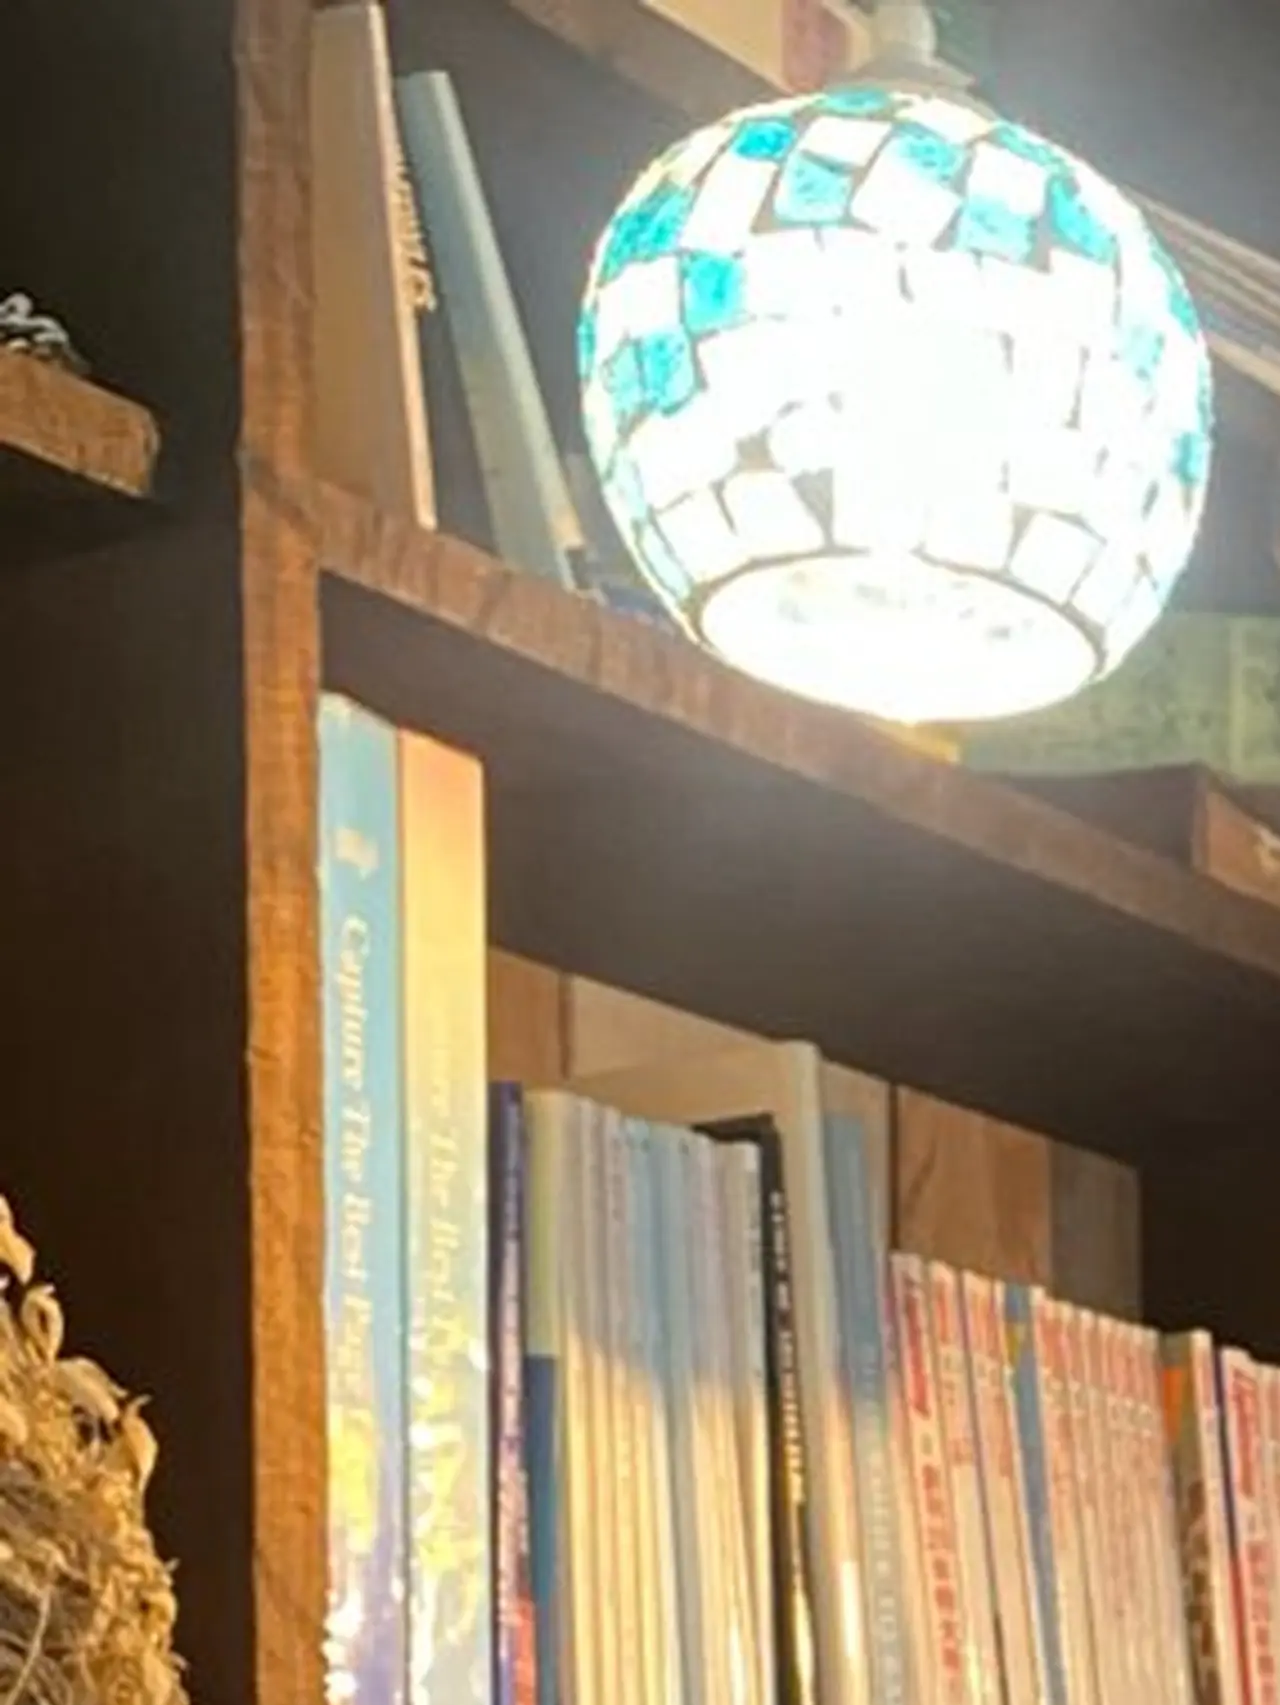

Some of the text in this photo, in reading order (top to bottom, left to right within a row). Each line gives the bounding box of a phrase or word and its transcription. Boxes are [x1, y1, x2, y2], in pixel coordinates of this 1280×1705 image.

[334, 914, 372, 1090] Capture
[340, 1100, 372, 1181] The
[340, 1192, 373, 1282] Best
